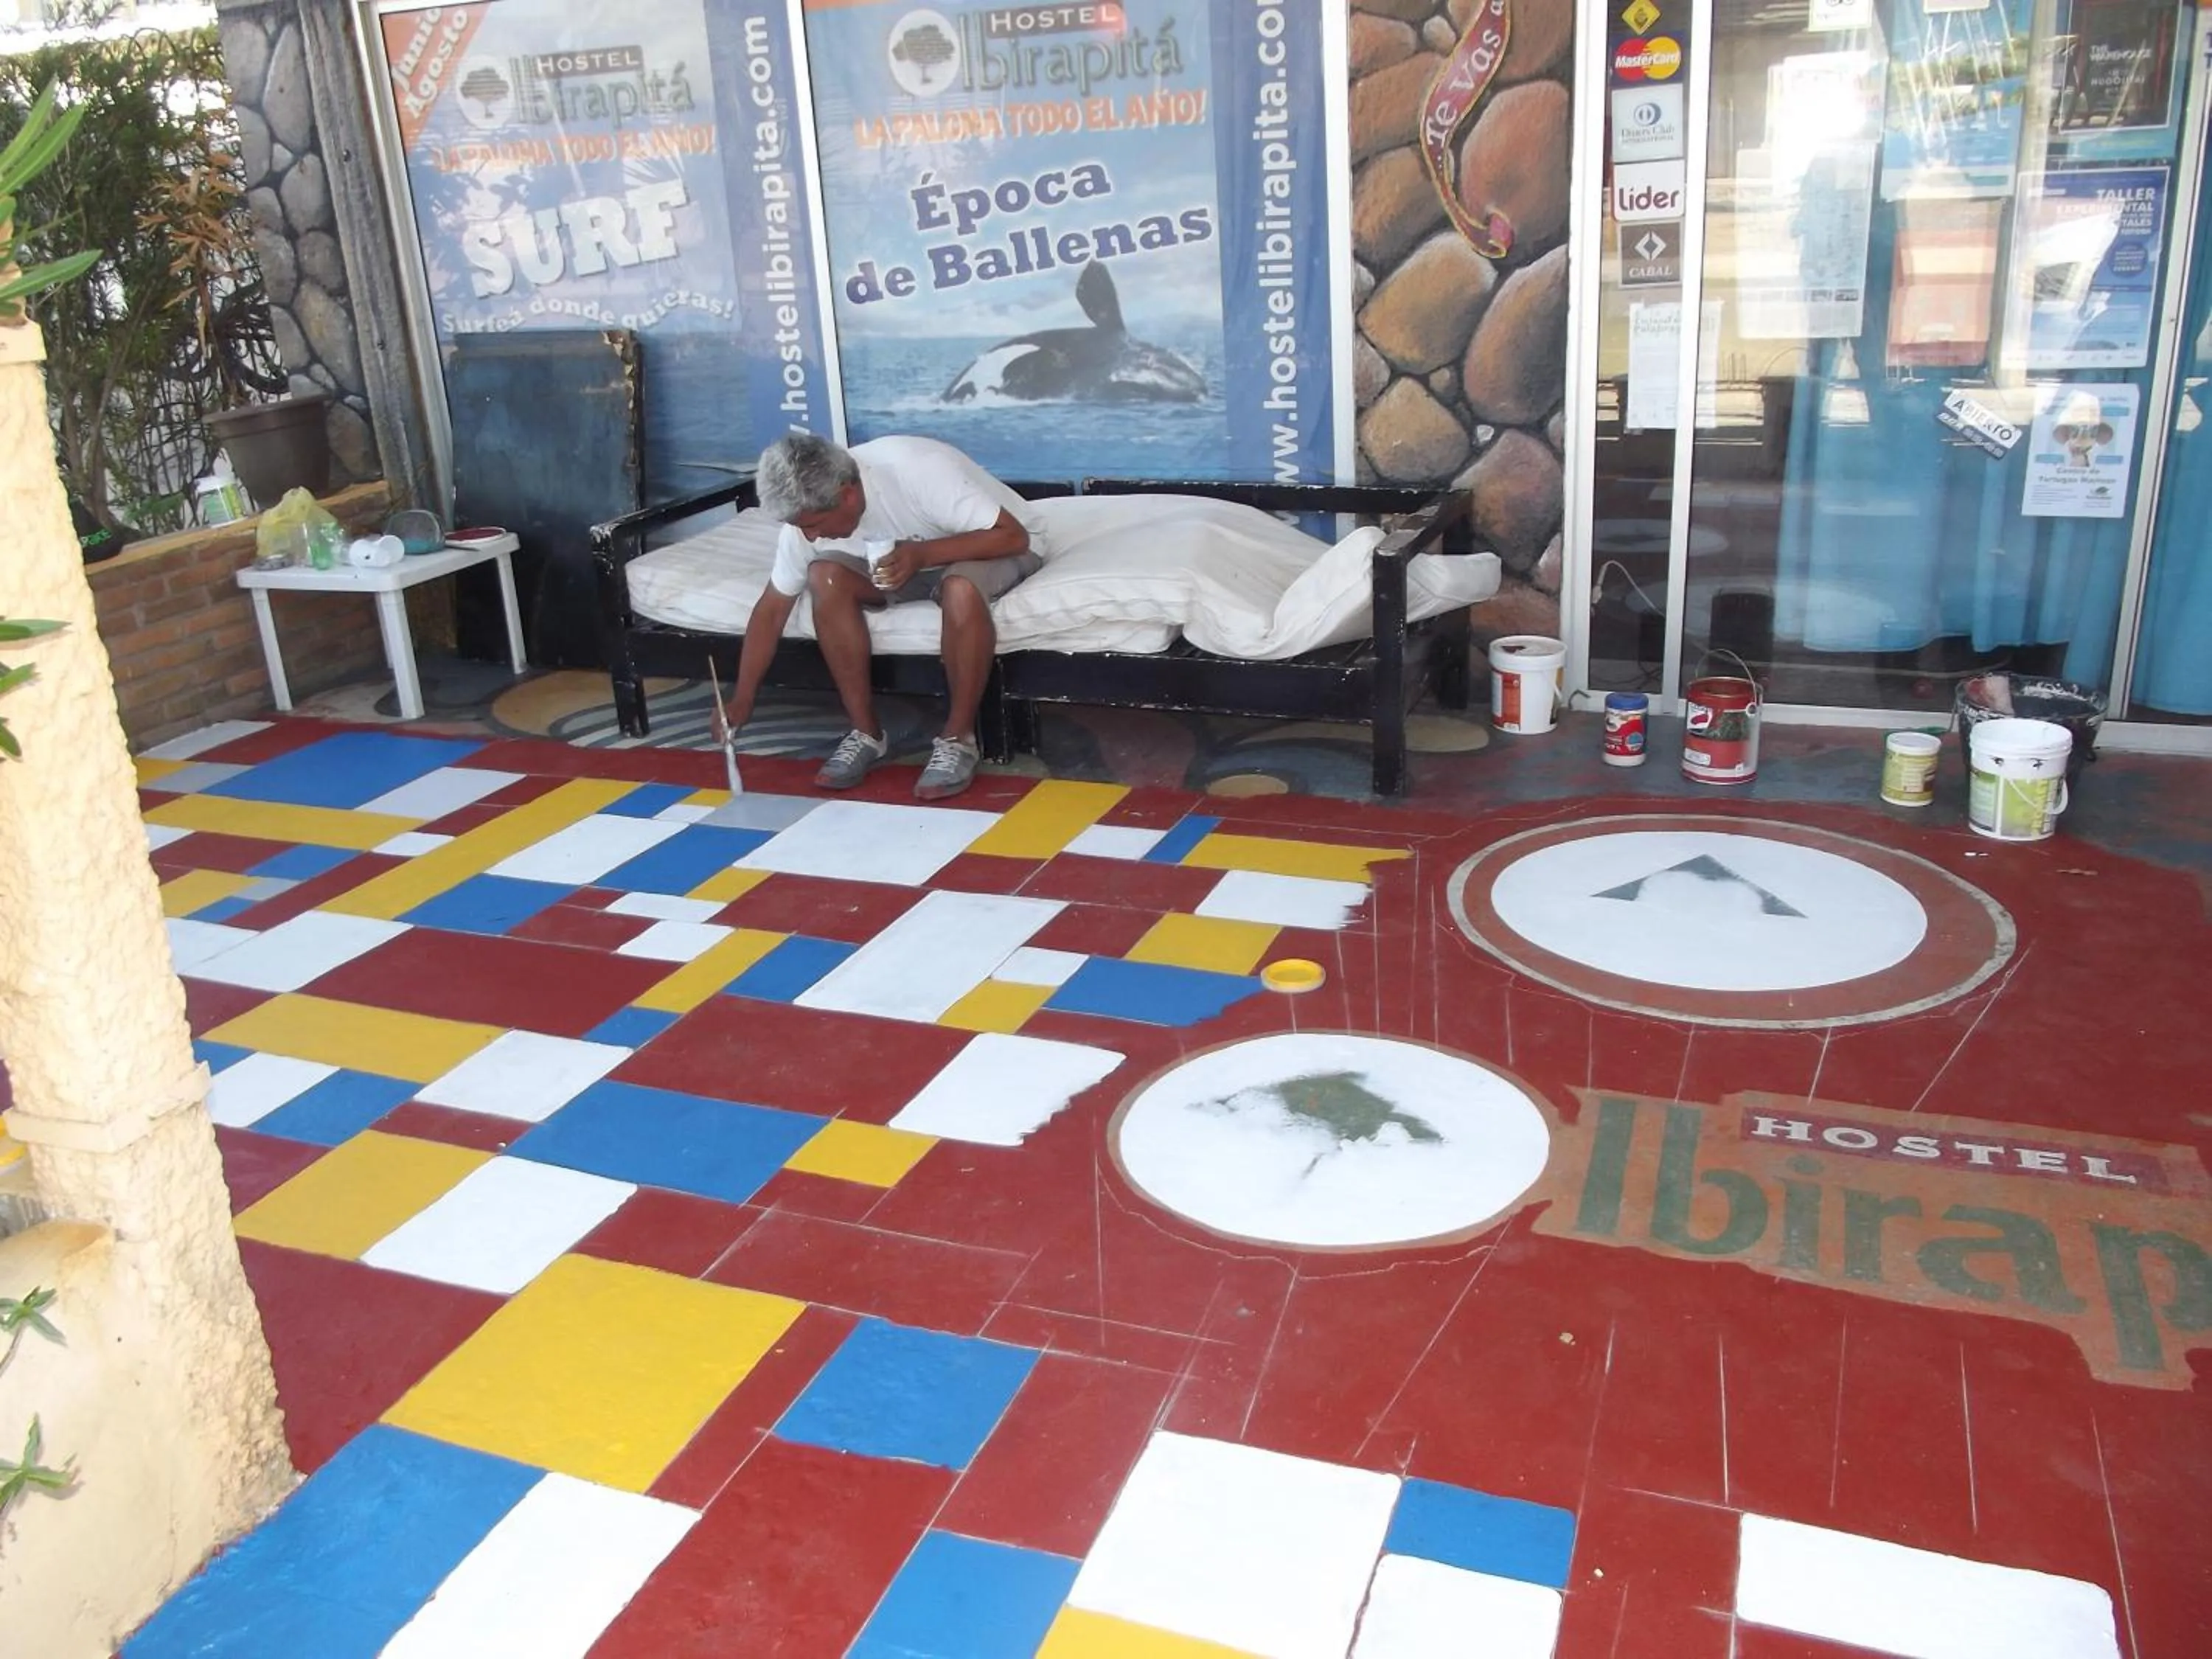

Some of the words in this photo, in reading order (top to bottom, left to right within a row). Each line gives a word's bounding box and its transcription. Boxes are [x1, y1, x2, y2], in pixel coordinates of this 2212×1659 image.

[990, 4, 1119, 33] HOSTEL
[406, 9, 467, 119] Agosto
[537, 50, 640, 74] HOSTEL
[959, 11, 1183, 95] Ibirapitá
[1615, 51, 1681, 68] MasterCard
[855, 115, 888, 147] LA
[891, 106, 1005, 145] PALOMA
[1006, 99, 1082, 136] TODO
[1085, 94, 1124, 132] EL
[1124, 88, 1208, 130] AÑO!
[1621, 127, 1650, 138] Diners
[1652, 124, 1674, 135] Club
[558, 134, 616, 164] TODO
[910, 164, 1111, 235] Época
[2097, 188, 2155, 201] TALLER
[461, 178, 692, 299] SURF
[846, 261, 916, 305] de
[928, 208, 1212, 290] Ballenas
[1253, 0, 1300, 484] ww.hostelibirapita.co
[1629, 265, 1674, 277] CABAL
[529, 296, 616, 325] donde
[621, 290, 734, 331] quieras!
[1751, 1116, 2138, 1185] HOSTEL
